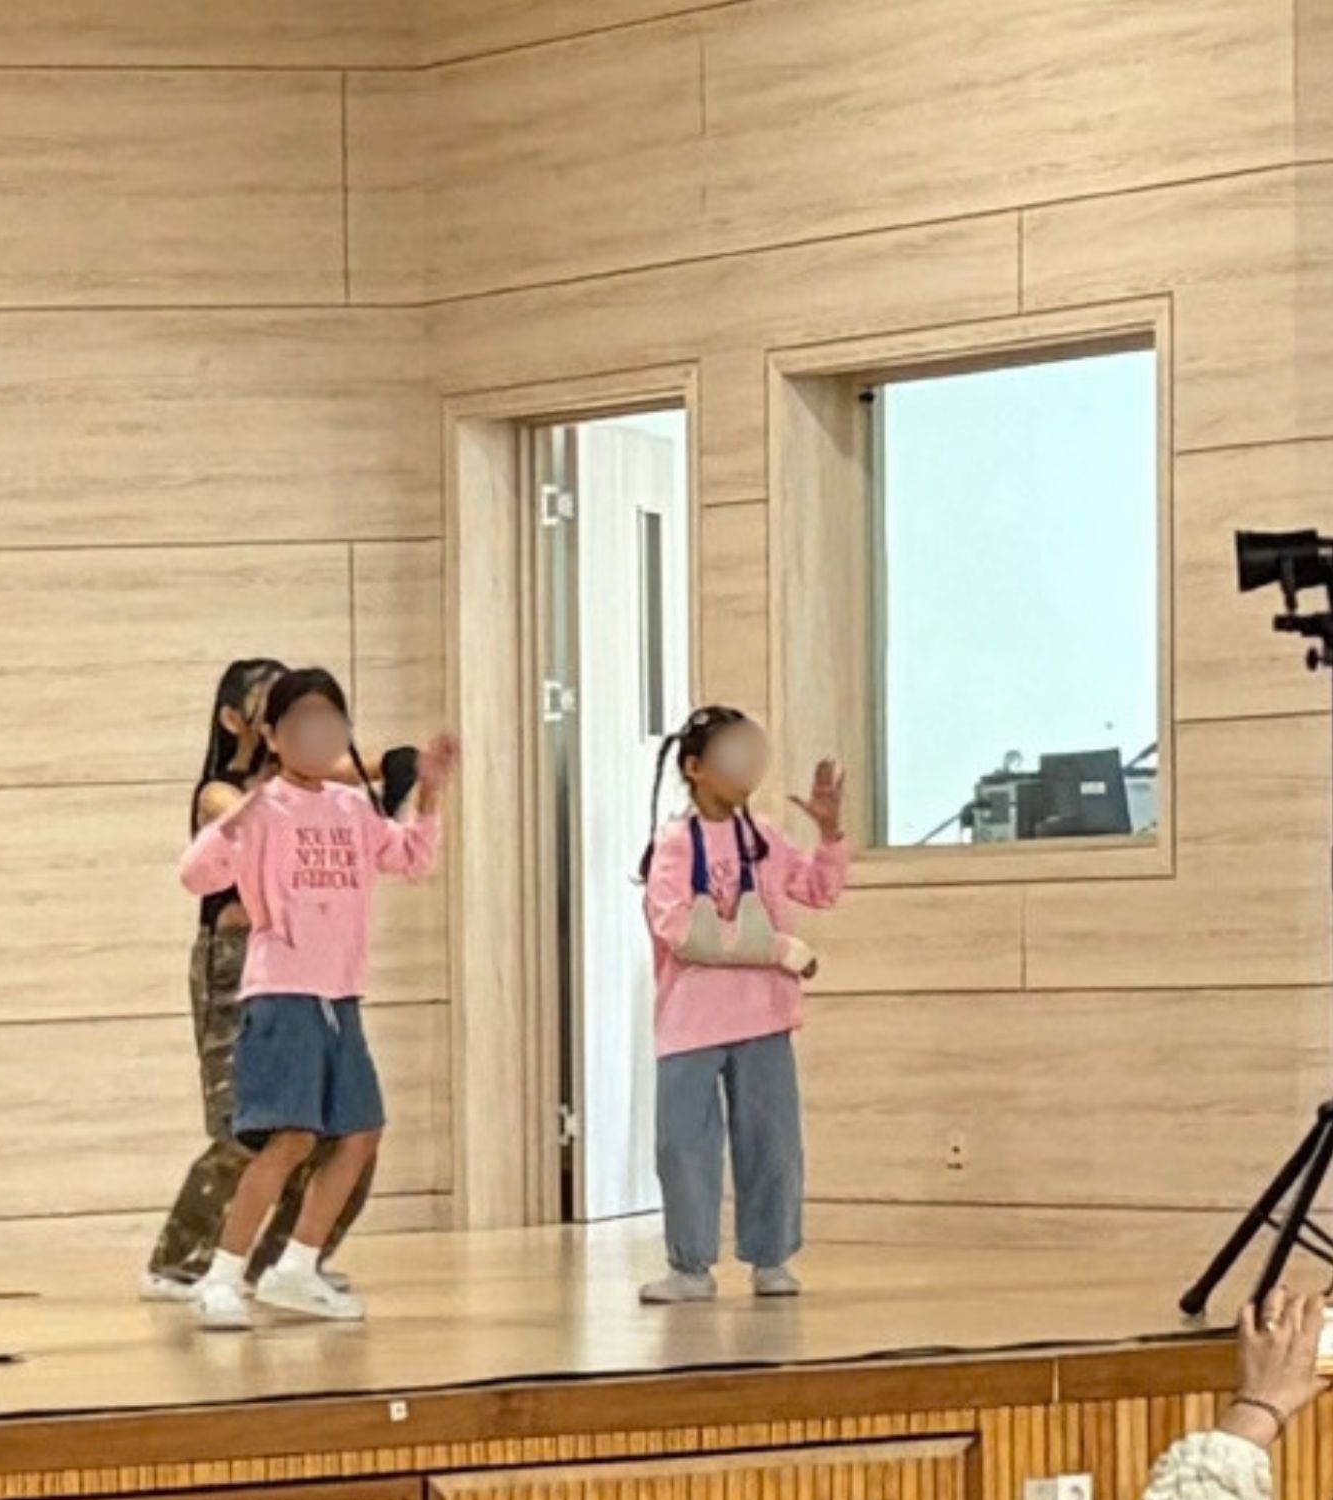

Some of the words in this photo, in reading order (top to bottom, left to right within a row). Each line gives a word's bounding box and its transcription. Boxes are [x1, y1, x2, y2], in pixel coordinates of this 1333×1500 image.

[295, 827, 326, 846] YOU
[295, 848, 326, 867] NOT
[329, 849, 357, 867] FOR
